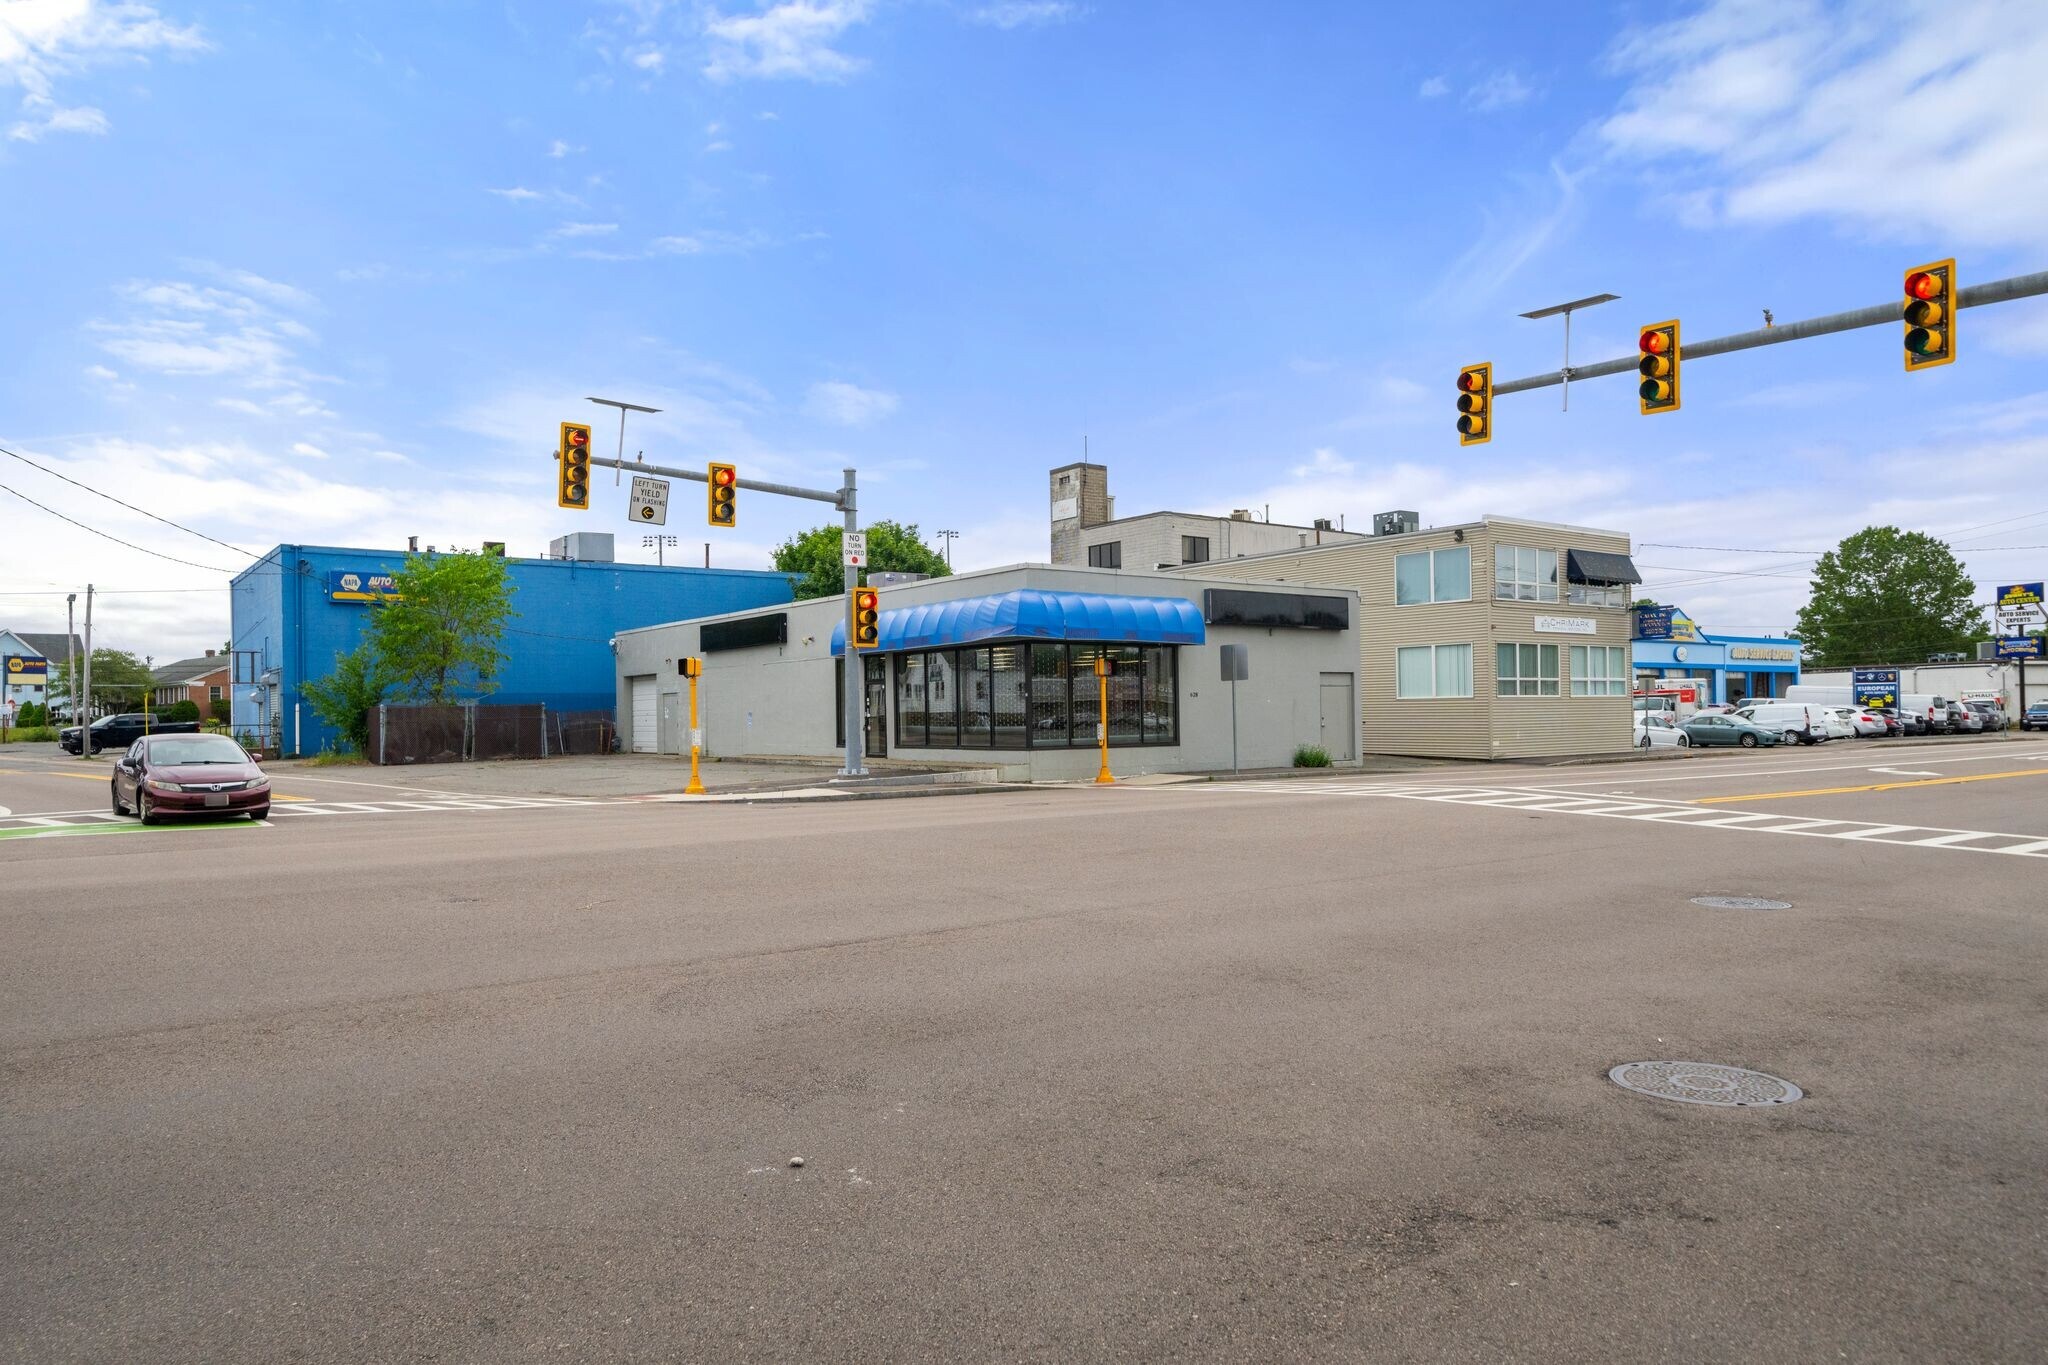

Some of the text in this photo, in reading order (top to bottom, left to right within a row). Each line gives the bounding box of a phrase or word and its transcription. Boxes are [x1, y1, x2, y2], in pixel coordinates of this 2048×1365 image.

[635, 480, 667, 490] LEFT TURN
[641, 489, 660, 498] YIELD
[642, 498, 665, 506] FLASHING
[344, 577, 392, 587] NAPA AUTO
